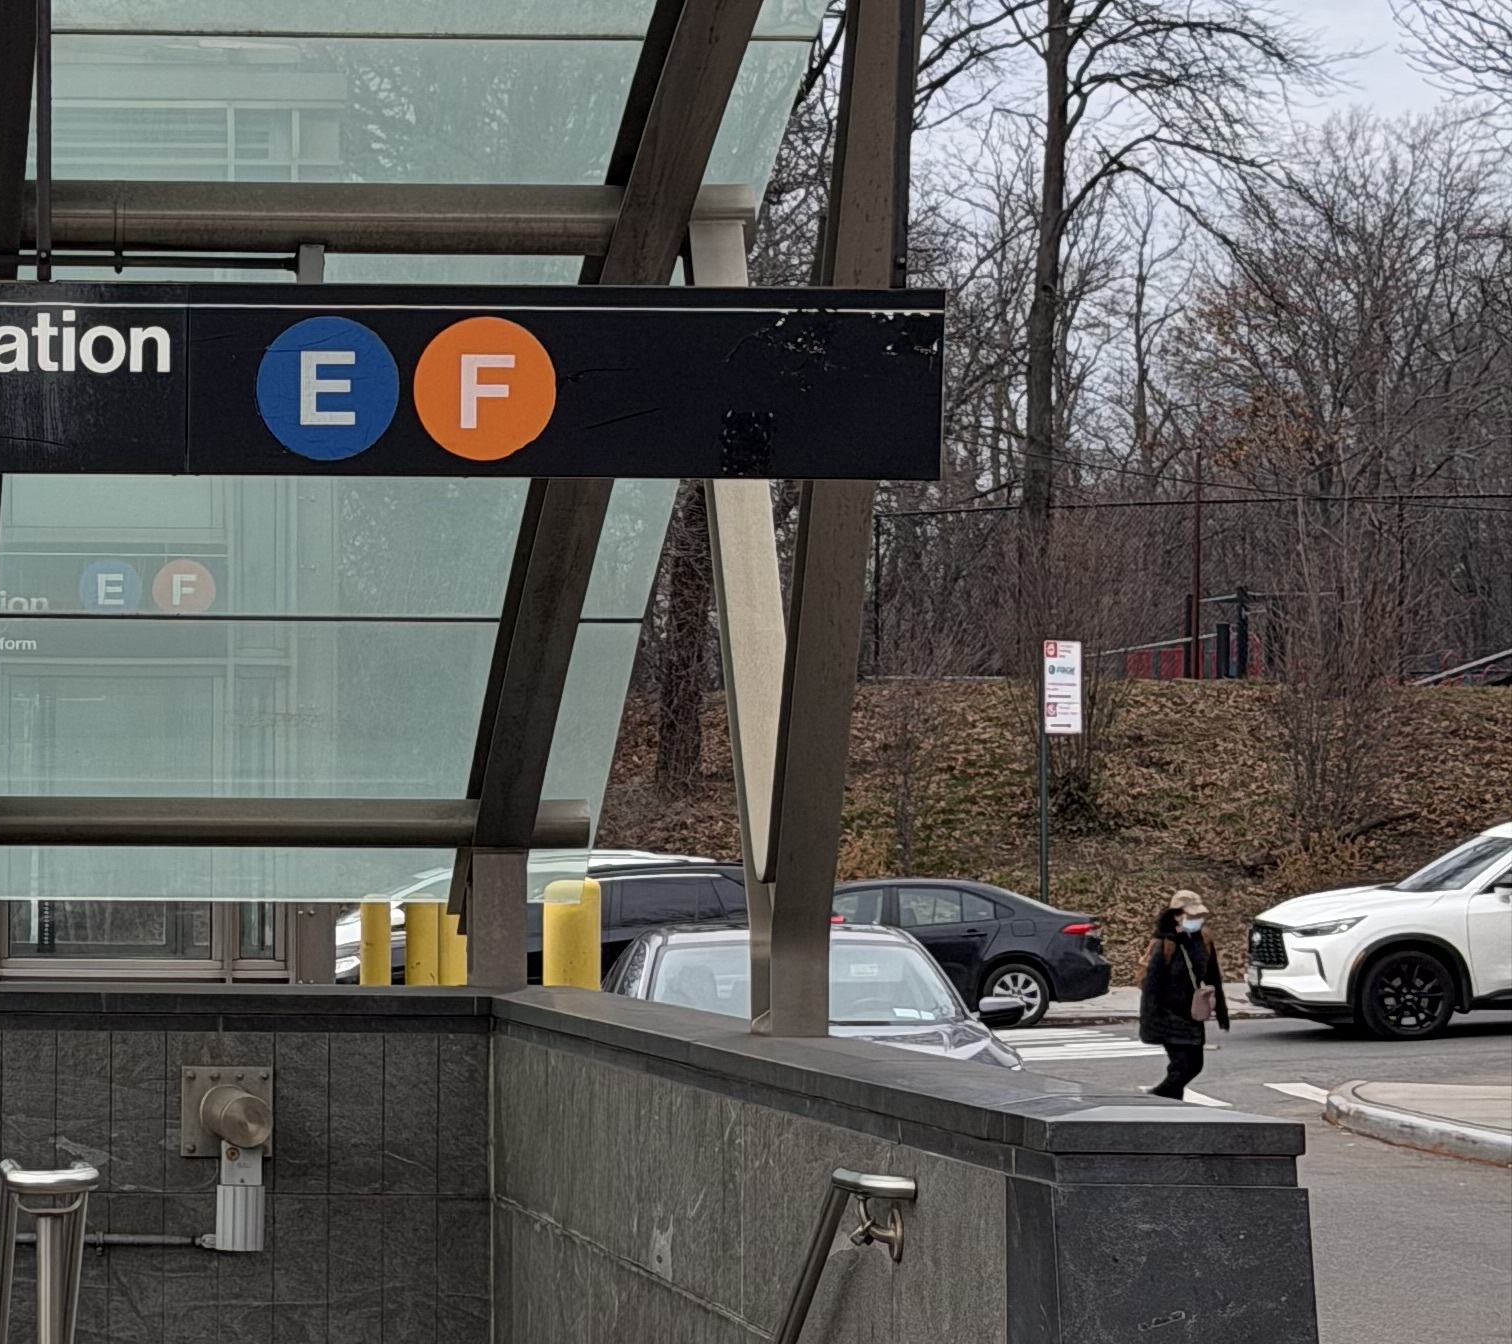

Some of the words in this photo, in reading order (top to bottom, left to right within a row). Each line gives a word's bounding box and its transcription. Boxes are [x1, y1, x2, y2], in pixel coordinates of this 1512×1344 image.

[299, 351, 356, 426] E
[459, 354, 516, 429] F
[96, 573, 125, 605] E
[172, 574, 196, 605] F
